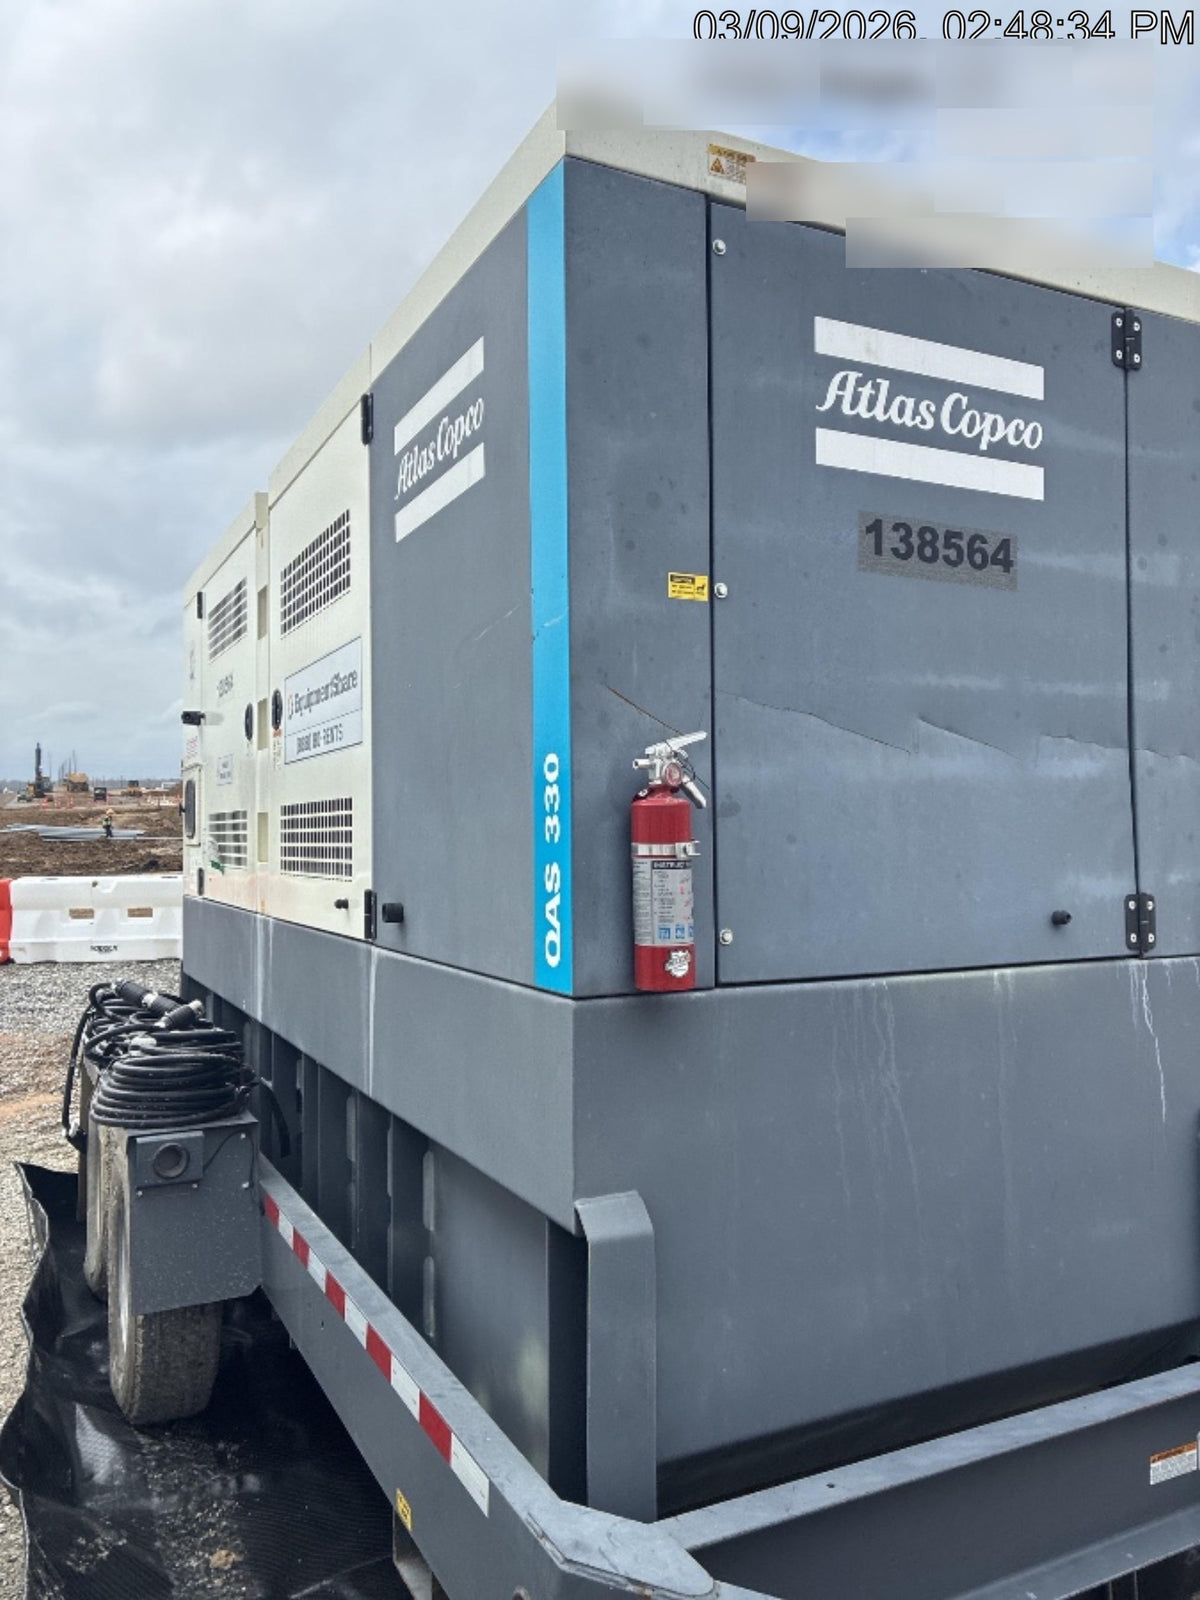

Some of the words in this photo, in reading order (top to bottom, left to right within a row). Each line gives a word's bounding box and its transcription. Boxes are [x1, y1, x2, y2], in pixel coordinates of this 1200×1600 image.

[394, 440, 435, 501] Atlas
[436, 397, 485, 461] Copco
[815, 370, 936, 430] Atlas
[940, 391, 1044, 451] Copco
[864, 518, 1014, 574] 138564
[543, 752, 561, 844] 330
[544, 861, 561, 968] QAS
